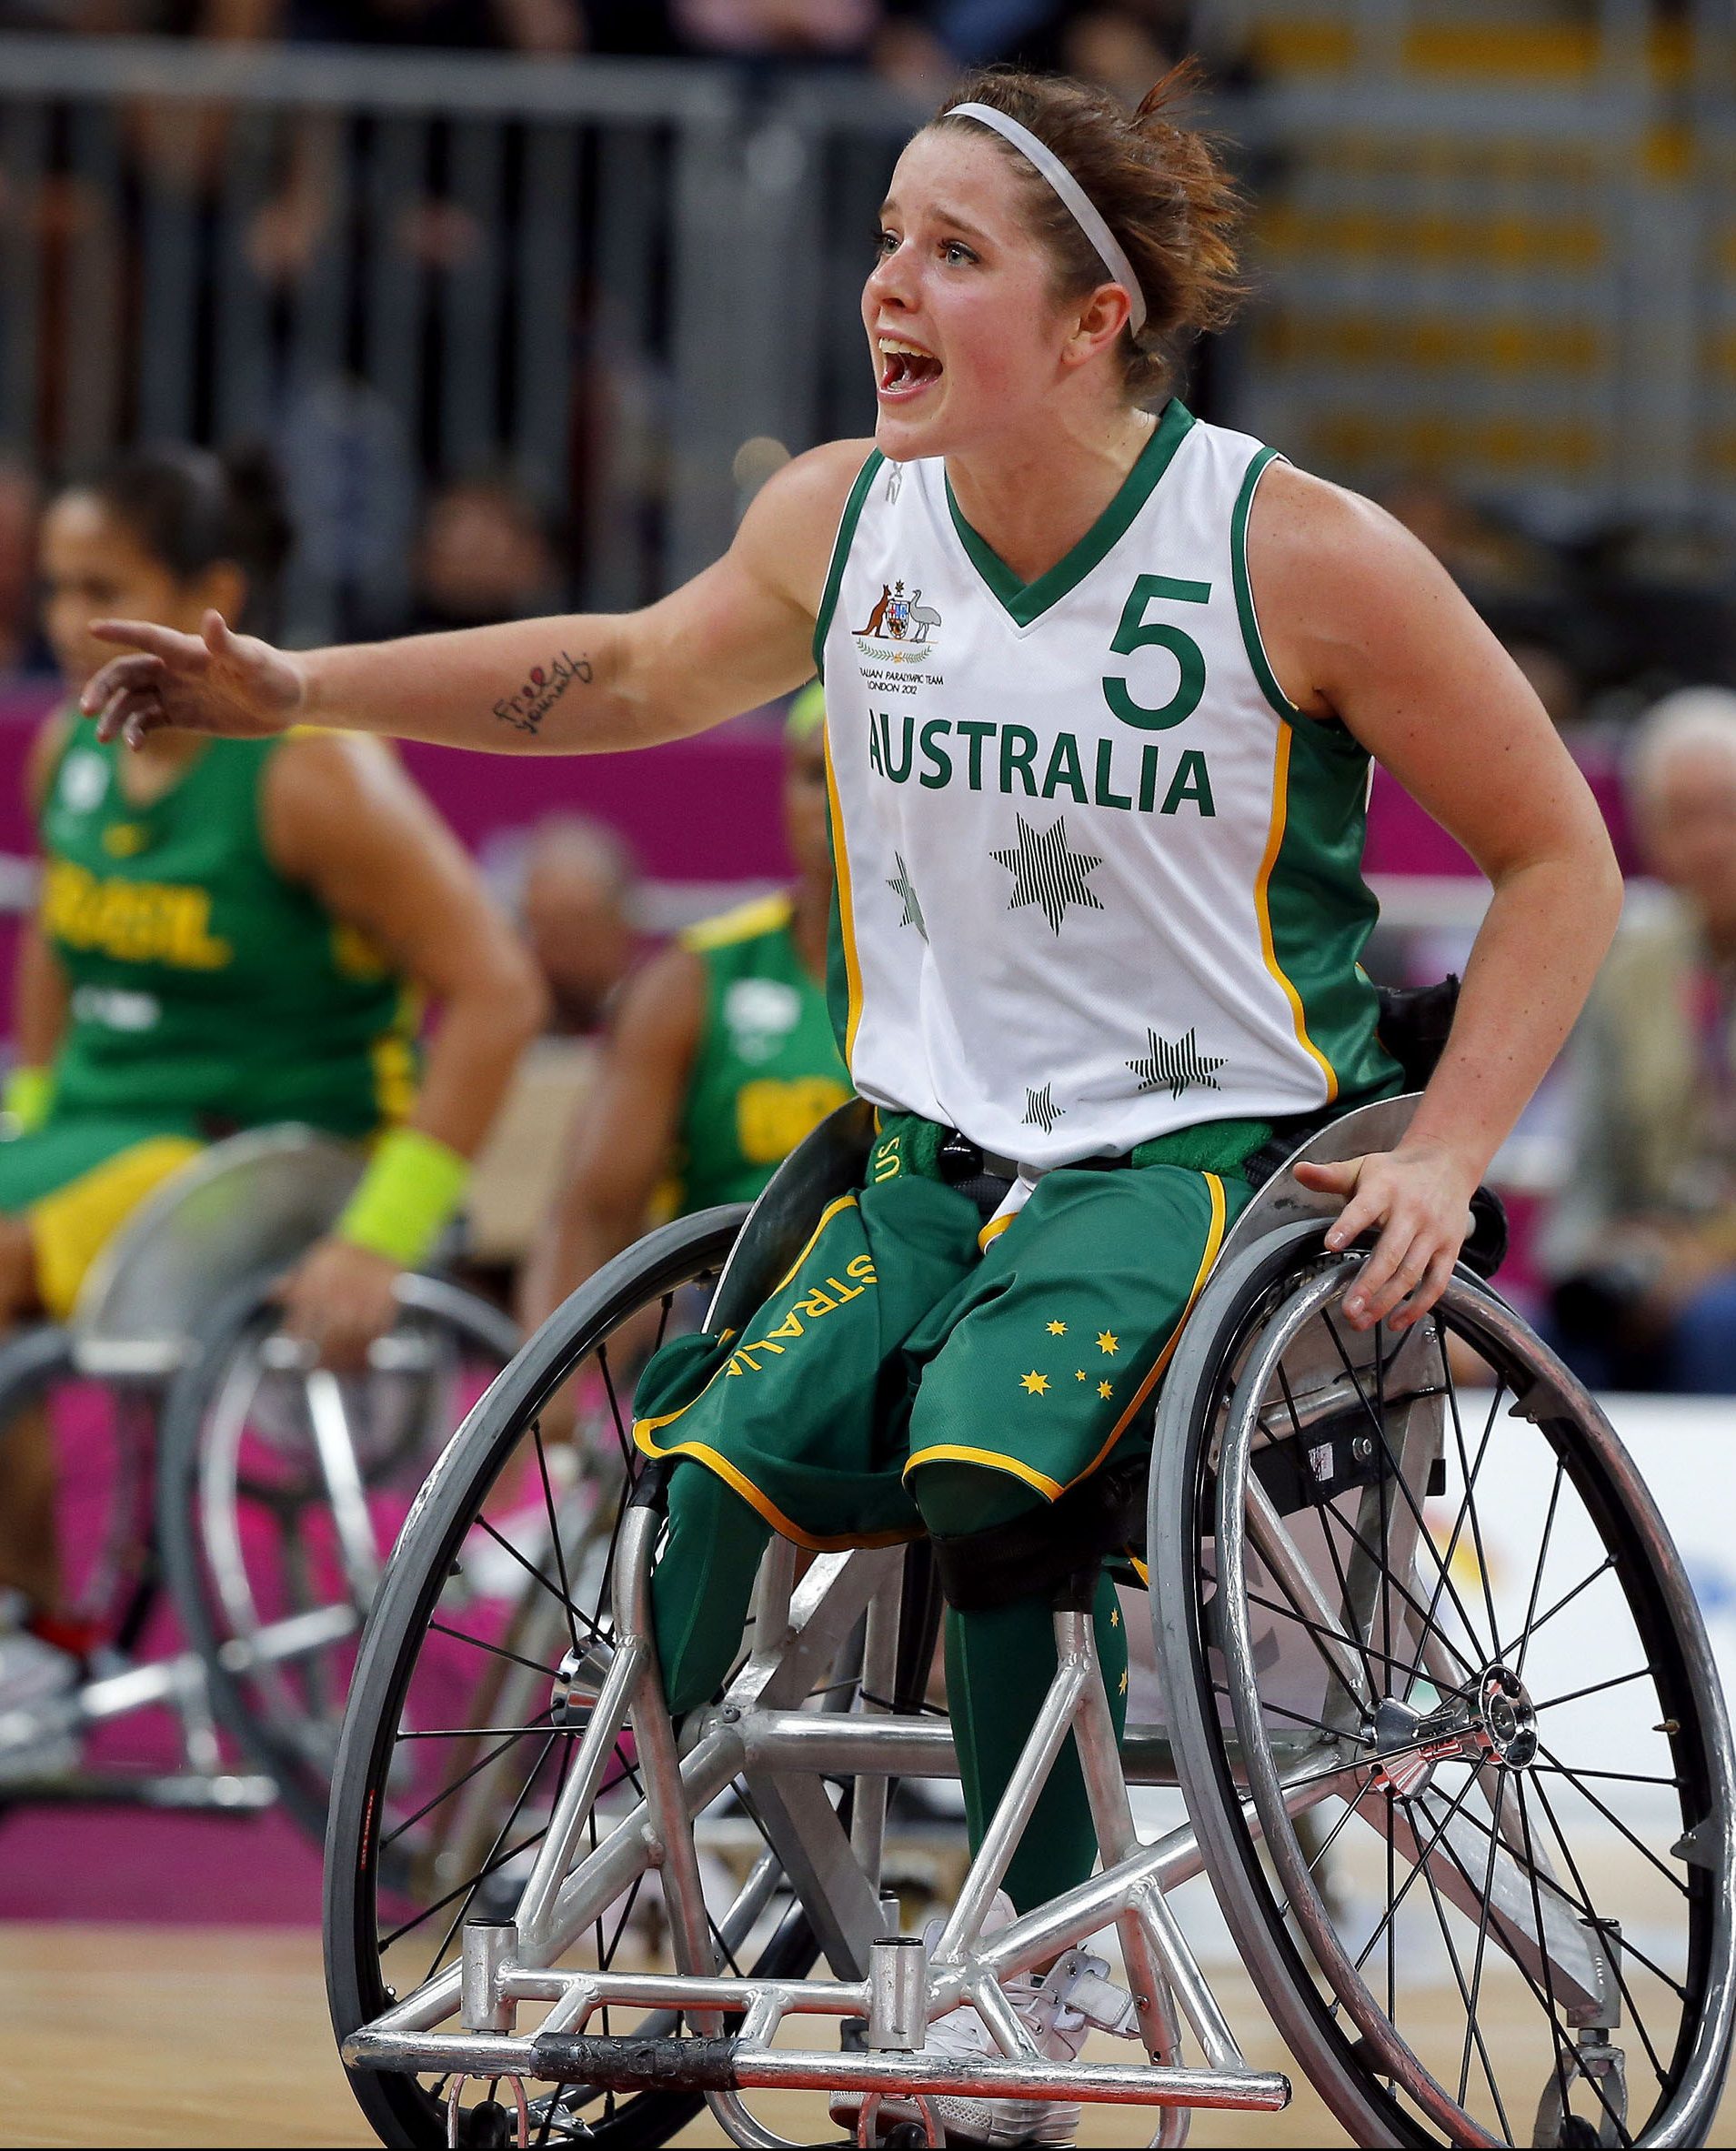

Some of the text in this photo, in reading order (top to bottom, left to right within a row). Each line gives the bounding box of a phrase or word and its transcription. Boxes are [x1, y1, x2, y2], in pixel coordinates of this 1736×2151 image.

[886, 671, 924, 684] PARALYMPIC
[925, 675, 944, 686] TEAM
[1102, 574, 1212, 730] 5
[867, 680, 918, 695] LONDON 2012
[868, 709, 1216, 817] AUSTRALIA
